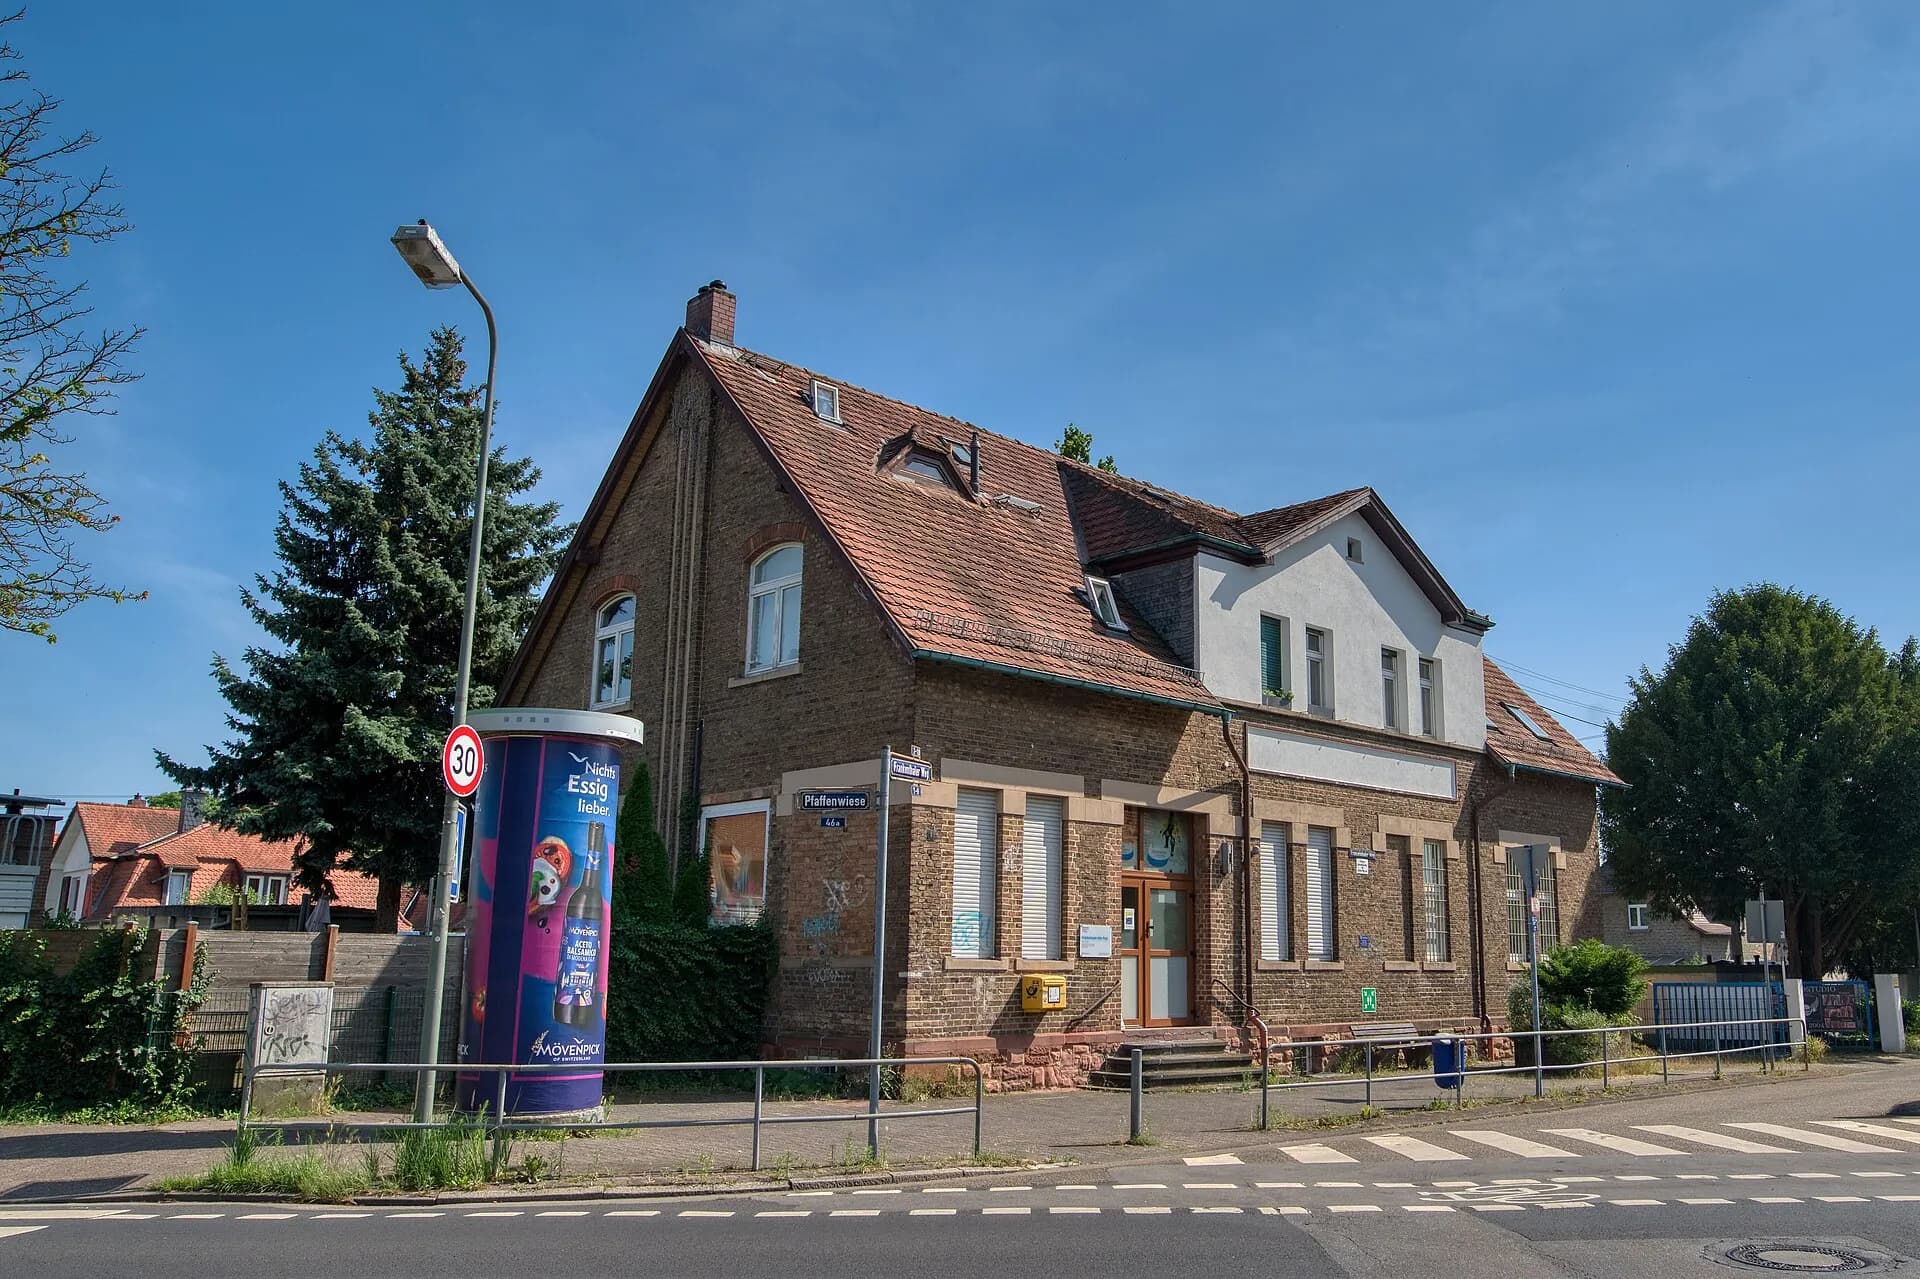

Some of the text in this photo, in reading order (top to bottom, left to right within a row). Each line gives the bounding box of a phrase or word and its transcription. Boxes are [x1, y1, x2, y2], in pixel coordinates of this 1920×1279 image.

[452, 744, 476, 777] 30
[585, 761, 616, 780] Nichts
[568, 774, 608, 802] Essig
[578, 798, 611, 816] lieber.
[804, 795, 867, 807] Pfaffenwiese
[574, 940, 593, 949] ACETO
[536, 1041, 600, 1056] MÖVENPICK
